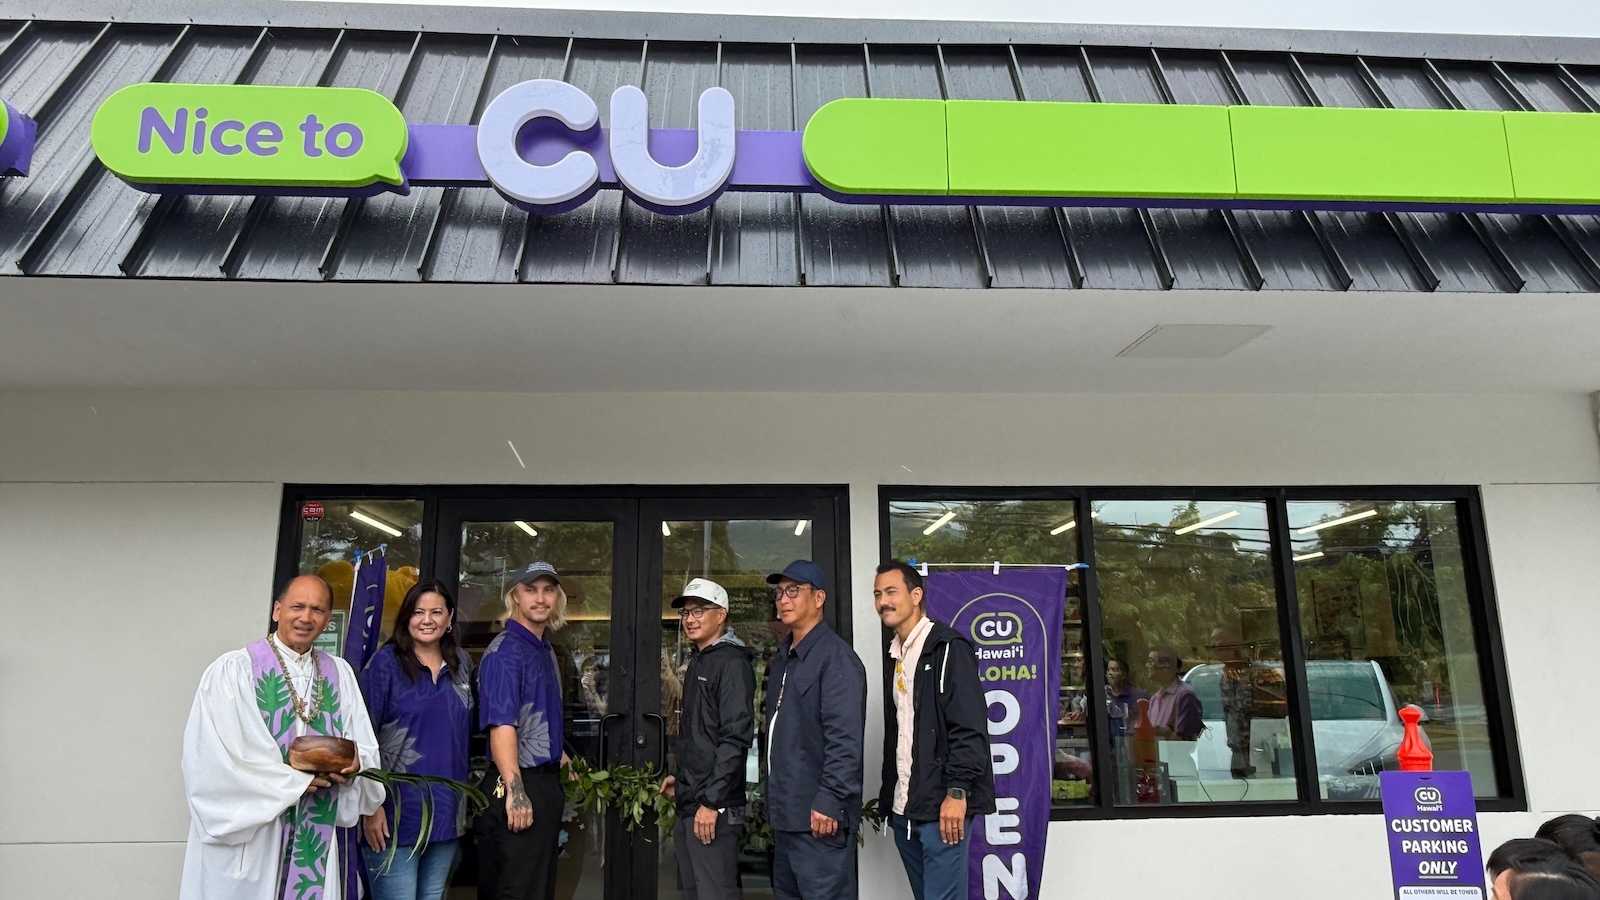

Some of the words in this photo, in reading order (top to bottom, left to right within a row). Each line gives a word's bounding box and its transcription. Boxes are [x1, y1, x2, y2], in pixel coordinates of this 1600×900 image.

[137, 106, 284, 156] Nice
[299, 113, 364, 158] to
[476, 78, 736, 207] CU
[980, 620, 1013, 638] CU
[981, 689, 1029, 900] OPEN
[1419, 790, 1437, 801] CU
[1391, 819, 1474, 833] CUSTOMER
[1401, 840, 1469, 854] PARKING
[1418, 861, 1458, 875] ONLY
